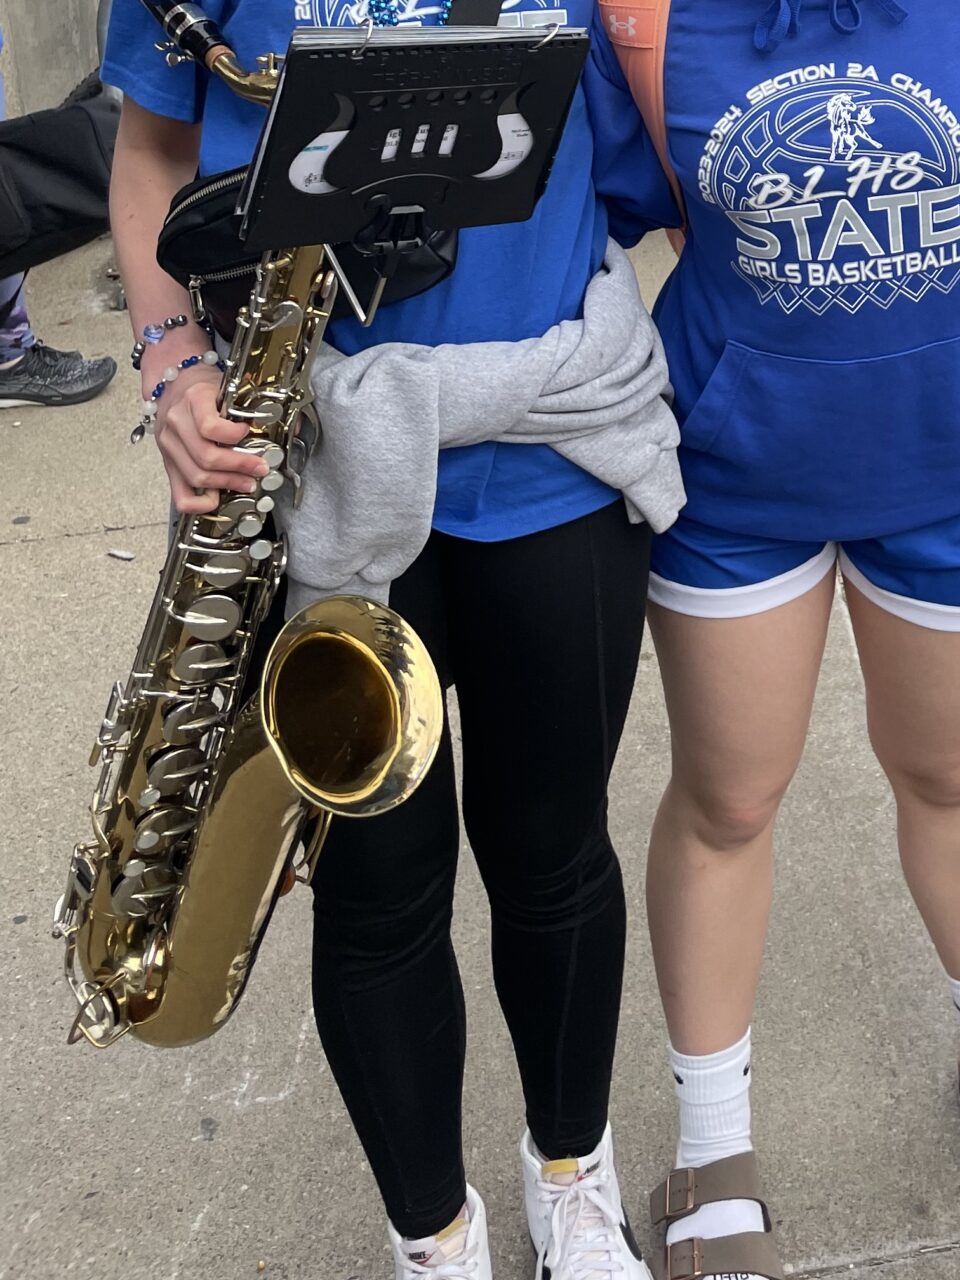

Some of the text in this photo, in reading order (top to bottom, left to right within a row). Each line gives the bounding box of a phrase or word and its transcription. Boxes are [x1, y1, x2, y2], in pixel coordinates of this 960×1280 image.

[697, 104, 743, 204] 2023-2024
[745, 63, 835, 105] SECTION
[846, 63, 879, 81] 2A
[739, 255, 802, 284] GIRLS
